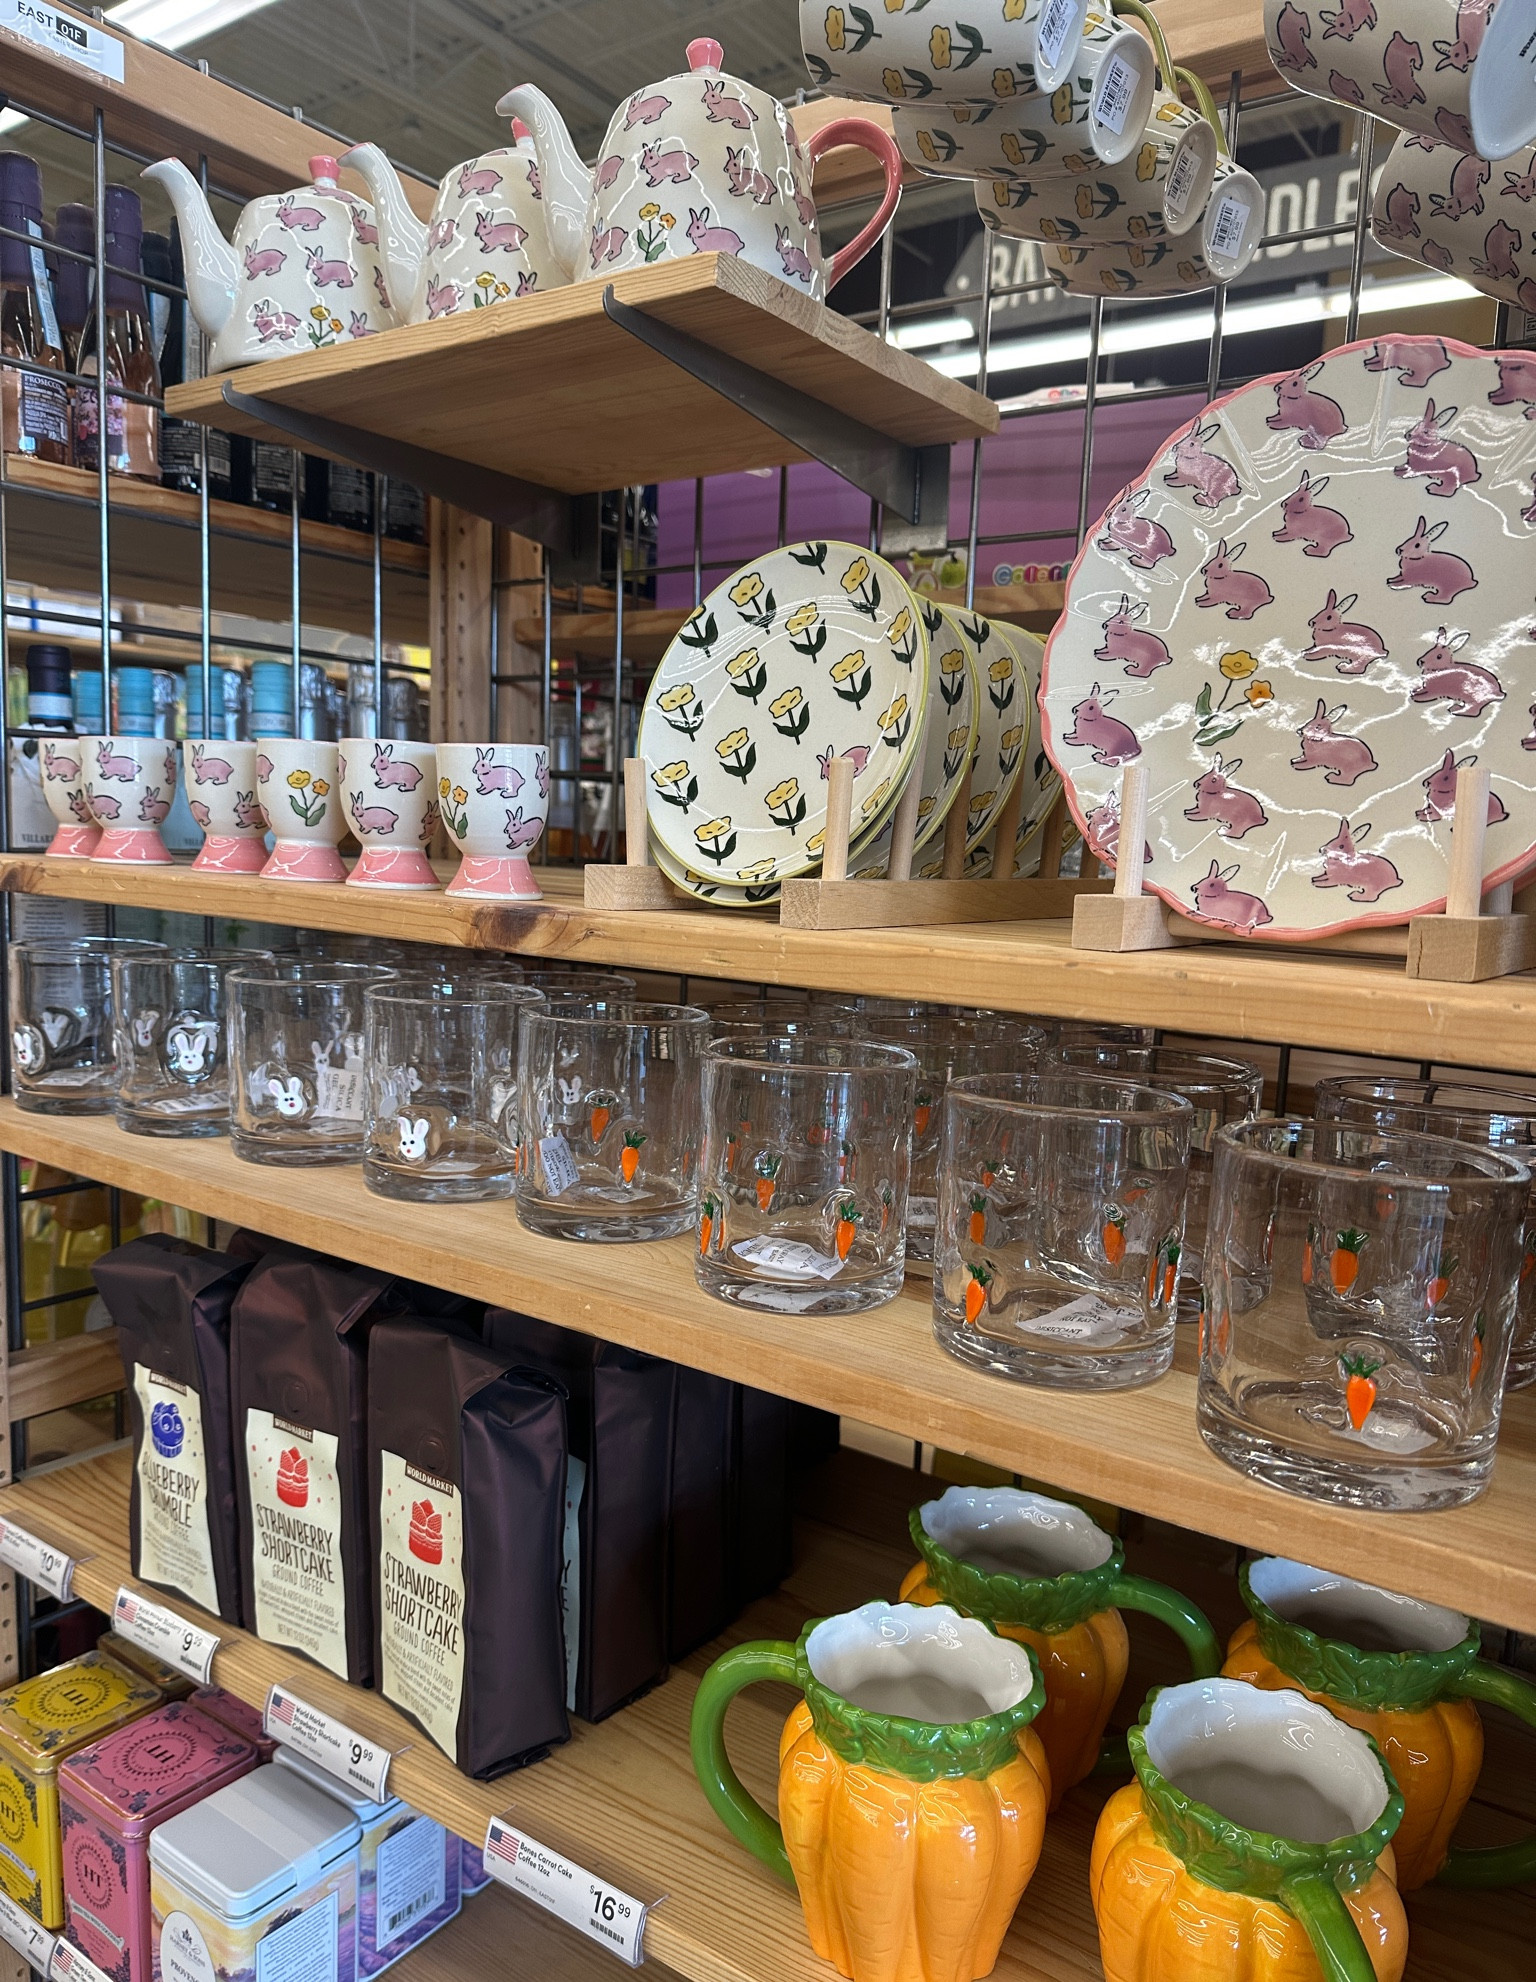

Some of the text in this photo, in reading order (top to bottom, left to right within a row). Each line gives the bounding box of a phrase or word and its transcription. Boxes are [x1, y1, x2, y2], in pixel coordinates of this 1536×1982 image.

[17, 1, 82, 41] EAST 01F
[407, 1466, 453, 1493] WORLD MARKET
[256, 1503, 334, 1556] STRAWBERRY
[261, 1531, 336, 1584] SHORTCAKE
[272, 1563, 325, 1598] GROUND COFFEE
[385, 1552, 462, 1619] STRAWBERRY
[385, 1584, 460, 1656] SHORTCAKE
[393, 1620, 419, 1648] GROUND
[421, 1637, 446, 1666] COFFEE
[292, 1723, 307, 1737] Coffee
[294, 1714, 318, 1735] Strawberry
[318, 1730, 341, 1748] Shortcake
[296, 1706, 326, 1728] World Market
[518, 1852, 550, 1877] Coffee 12oz
[520, 1842, 573, 1879] Bones Carrot Cake
